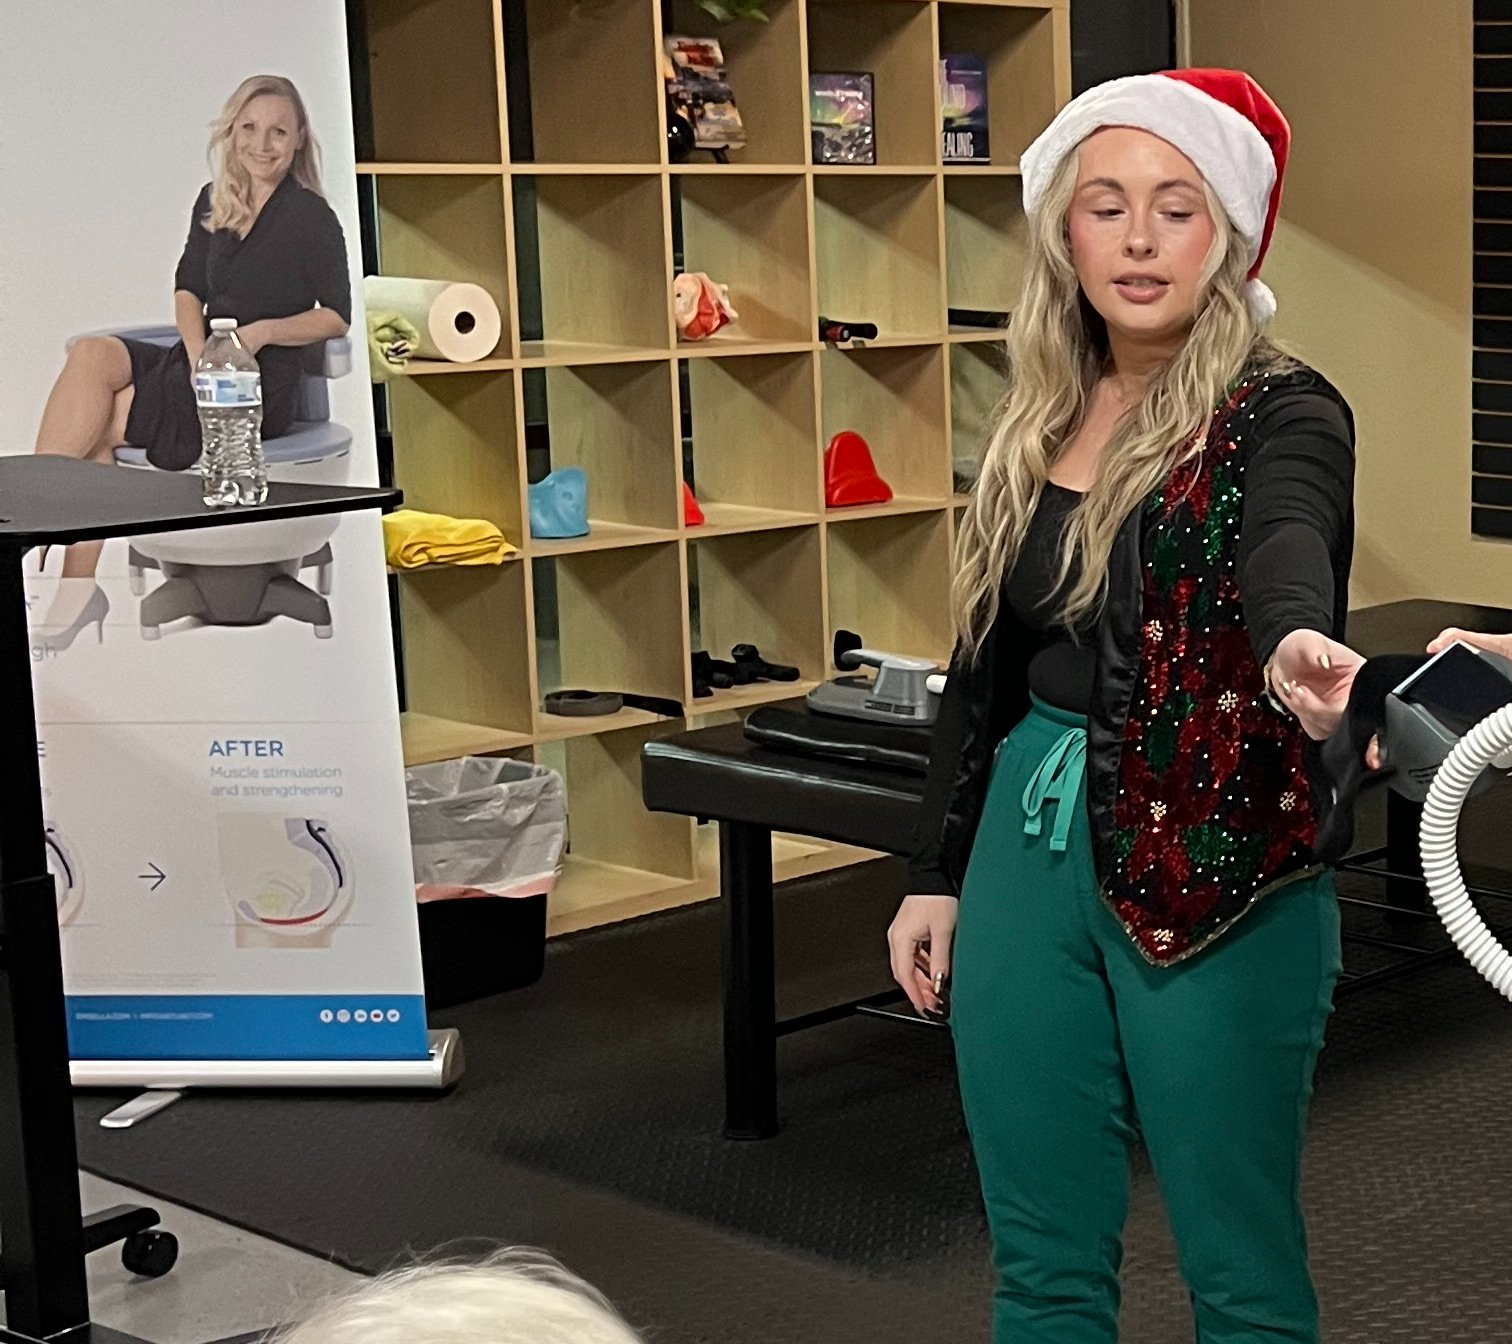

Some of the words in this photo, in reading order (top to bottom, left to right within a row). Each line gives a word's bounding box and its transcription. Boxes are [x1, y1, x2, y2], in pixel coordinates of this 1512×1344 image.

[209, 740, 284, 757] AFTER
[210, 766, 259, 778] Muscle
[263, 766, 342, 778] stimulation
[211, 785, 239, 796] and
[243, 785, 343, 797] strengthening
